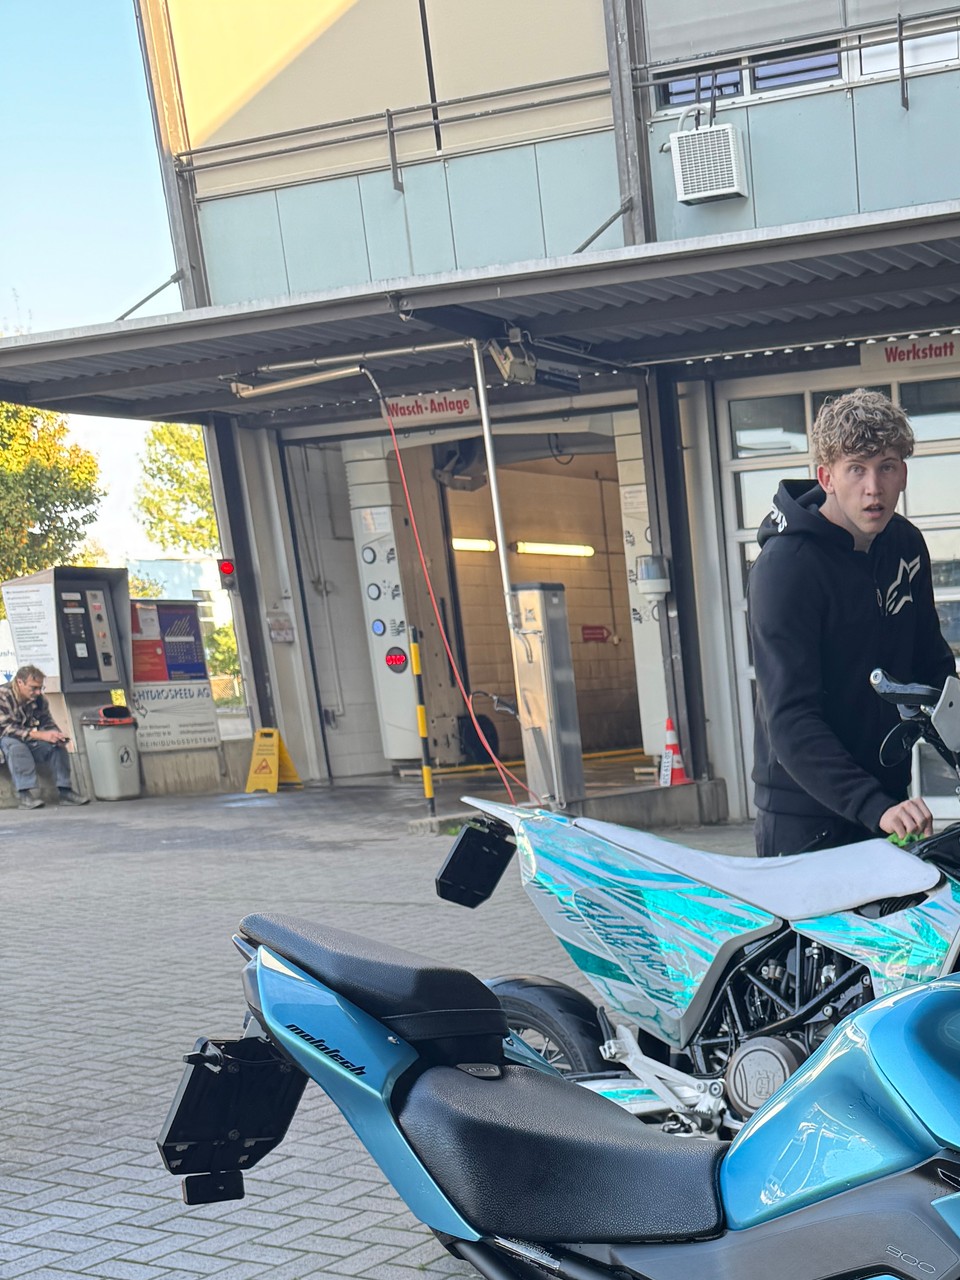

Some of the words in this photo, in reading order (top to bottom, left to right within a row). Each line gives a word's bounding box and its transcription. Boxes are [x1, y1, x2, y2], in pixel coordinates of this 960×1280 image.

[885, 341, 954, 363] Werkstatt
[386, 654, 406, 666] STOP
[197, 687, 210, 698] AG
[284, 1023, 367, 1077] mototech
[885, 1244, 936, 1274] 900
